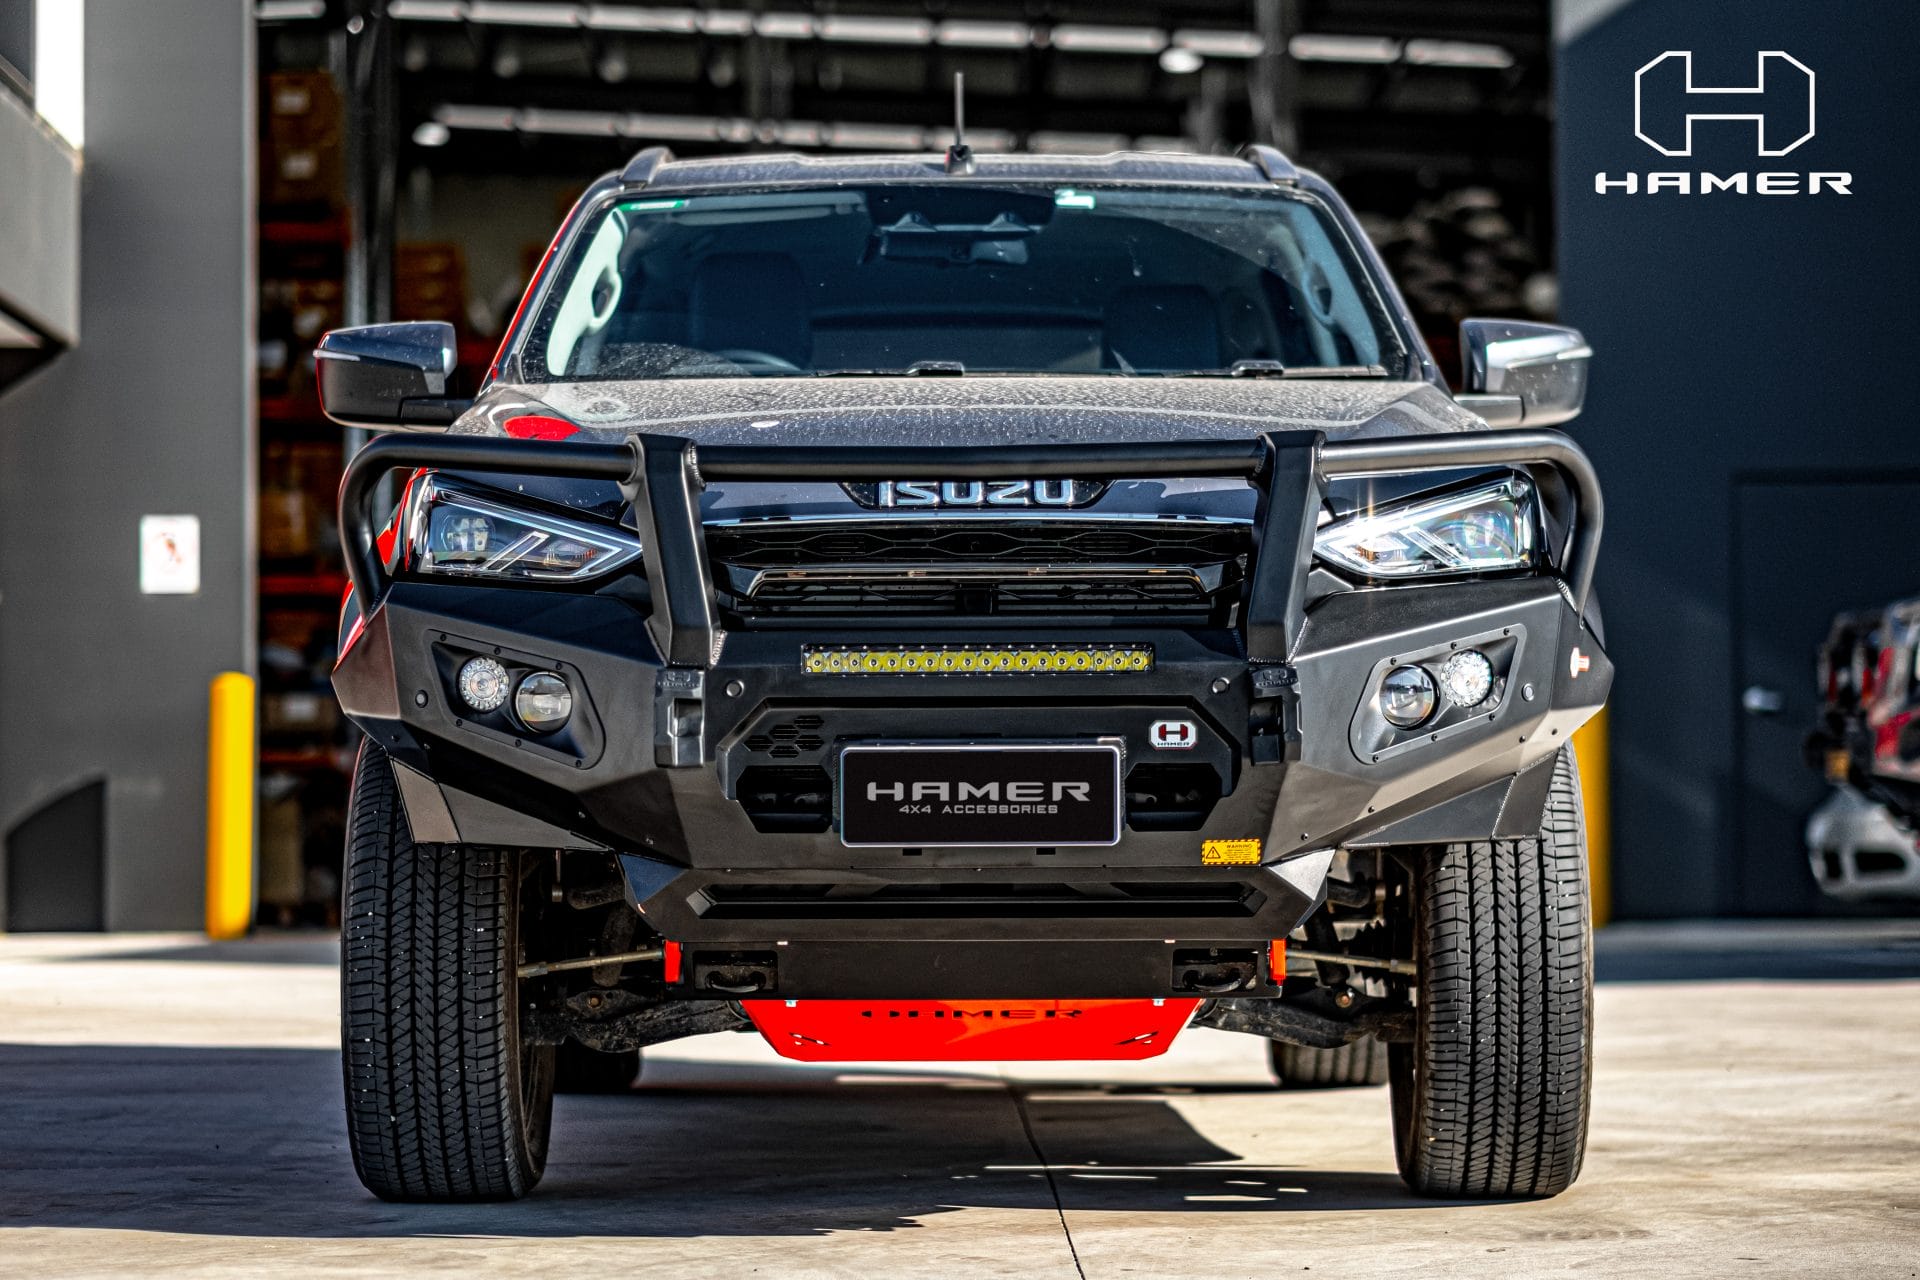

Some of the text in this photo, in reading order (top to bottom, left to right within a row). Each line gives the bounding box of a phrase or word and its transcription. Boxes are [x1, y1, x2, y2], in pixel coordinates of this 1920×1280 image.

[879, 480, 1075, 507] ISUZU
[866, 781, 1091, 801] HAMER
[899, 804, 1058, 814] 4X4 ACCESSORIES
